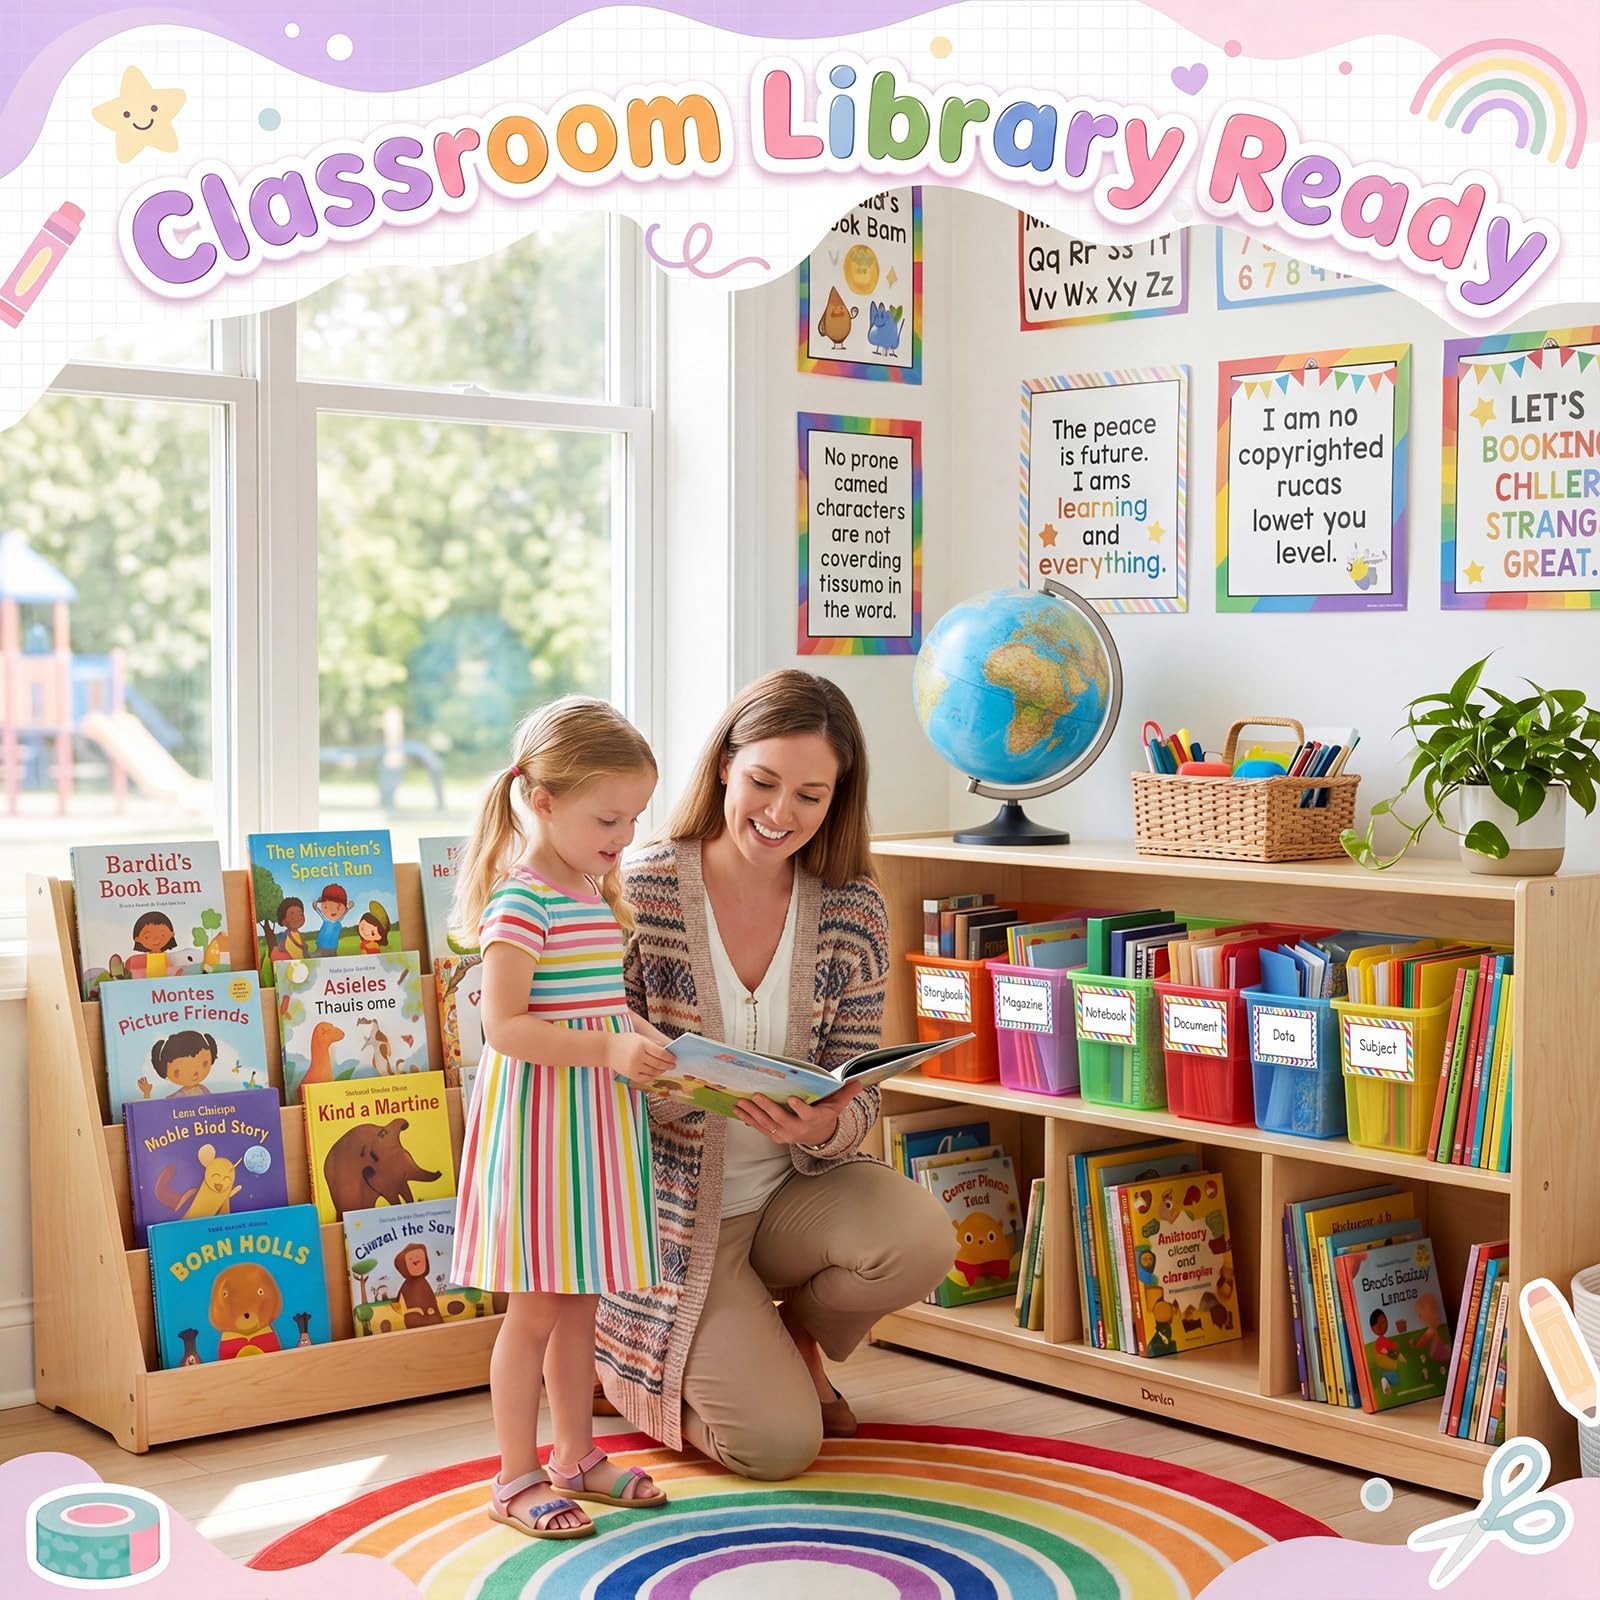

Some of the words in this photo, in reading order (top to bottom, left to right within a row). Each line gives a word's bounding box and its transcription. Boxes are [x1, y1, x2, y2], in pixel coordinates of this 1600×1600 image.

[867, 216, 906, 243] Bam
[1029, 246, 1060, 274] Qq
[1070, 240, 1097, 266] Rr
[1029, 287, 1057, 310] Vv
[1064, 281, 1098, 307] Wx
[1107, 276, 1137, 306] Xy
[1146, 271, 1174, 298] Zz
[1511, 390, 1585, 424] LET'S
[1052, 419, 1087, 440] The
[1094, 417, 1156, 443] peace
[1263, 408, 1275, 431] I
[1284, 411, 1320, 430] am
[1330, 407, 1358, 427] no
[1060, 446, 1074, 467] is
[1081, 444, 1149, 464] future.
[1238, 434, 1383, 470] copyrighted
[1482, 430, 1600, 463] BOOKIN
[825, 447, 846, 466] No
[851, 453, 898, 471] prone
[834, 476, 888, 494] camed
[1073, 471, 1083, 492] I
[1089, 473, 1131, 491] ams
[1277, 477, 1342, 497] rucas
[816, 498, 905, 520] characters
[1058, 497, 1147, 522] learning
[1253, 507, 1314, 532] lowet
[1323, 510, 1366, 535] you
[1486, 508, 1600, 541] STRANG
[831, 527, 859, 543] are
[865, 526, 891, 544] not
[1083, 524, 1120, 546] and
[821, 550, 901, 573] coverding
[1276, 539, 1337, 564] level.
[1503, 547, 1598, 579] GREAT.
[1039, 550, 1167, 579] everything.
[819, 574, 883, 593] tissumo
[888, 577, 901, 593] in
[823, 600, 849, 618] the
[855, 601, 897, 619] word.
[266, 844, 295, 860] The
[299, 840, 381, 859] Mivehien's
[105, 853, 192, 874] Bardid's
[342, 861, 373, 876] Run
[99, 879, 151, 898] Book
[155, 877, 202, 895] Bam
[151, 987, 214, 1004] Montes
[324, 976, 387, 996] Asieles
[315, 998, 364, 1015] Thauis
[367, 998, 396, 1010] ome
[1002, 996, 1043, 1012] Magazine
[1085, 1007, 1127, 1021] Notebook
[118, 1010, 179, 1035] Picture
[184, 1005, 249, 1025] Friends
[1173, 1017, 1218, 1033] Document
[1359, 1039, 1397, 1056] Subject
[318, 1102, 355, 1122] Kind
[360, 1105, 370, 1117] a
[375, 1095, 440, 1115] Martine
[231, 1120, 269, 1144] Story
[402, 1222, 424, 1237] the
[169, 1238, 233, 1282] BORN
[239, 1234, 310, 1265] HOLLS
